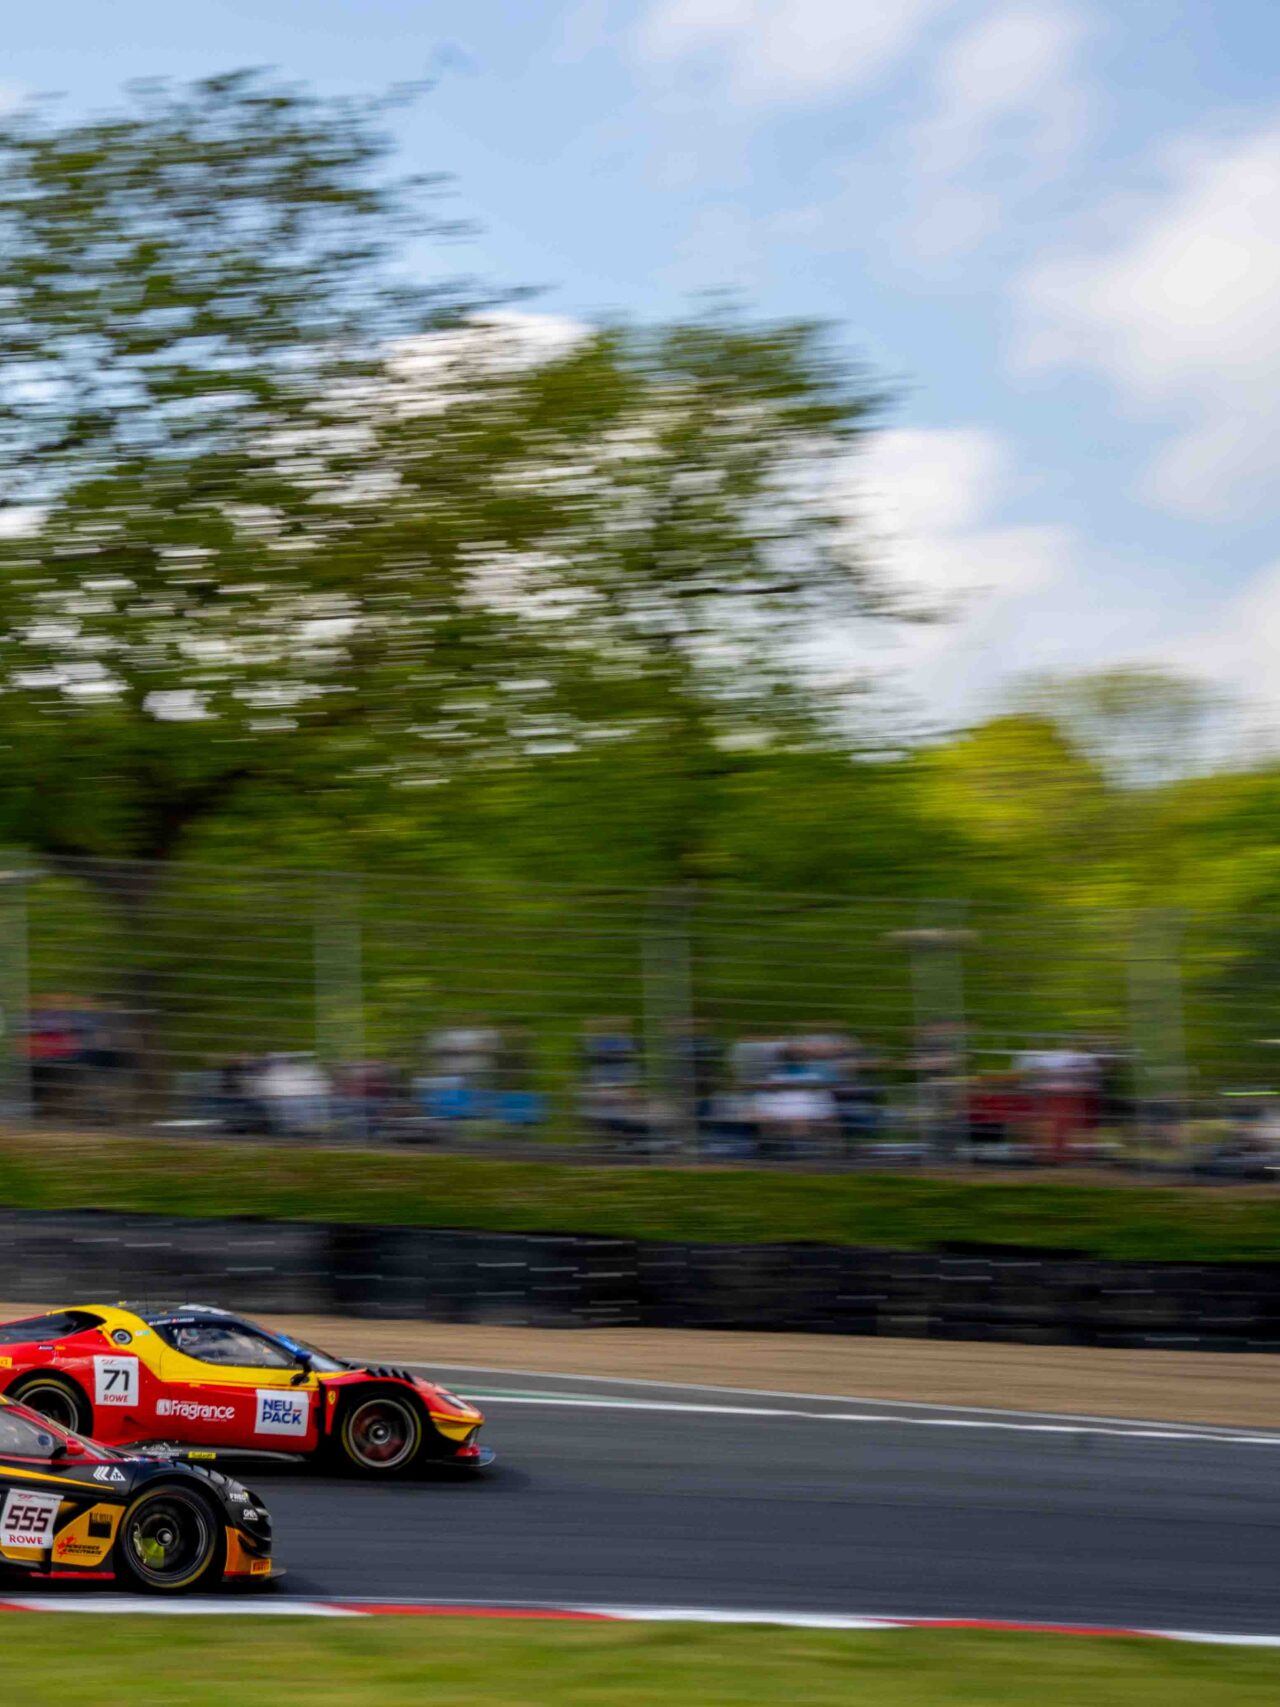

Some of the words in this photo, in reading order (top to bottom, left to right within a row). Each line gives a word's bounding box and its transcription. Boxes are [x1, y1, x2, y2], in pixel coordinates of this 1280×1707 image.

[104, 1370, 130, 1391] 71
[104, 1394, 128, 1403] ROWE
[263, 1399, 292, 1412] NEU
[171, 1400, 235, 1420] Fragrance
[262, 1411, 302, 1425] PACK
[5, 1505, 53, 1532] 555
[9, 1534, 43, 1545] ROWE
